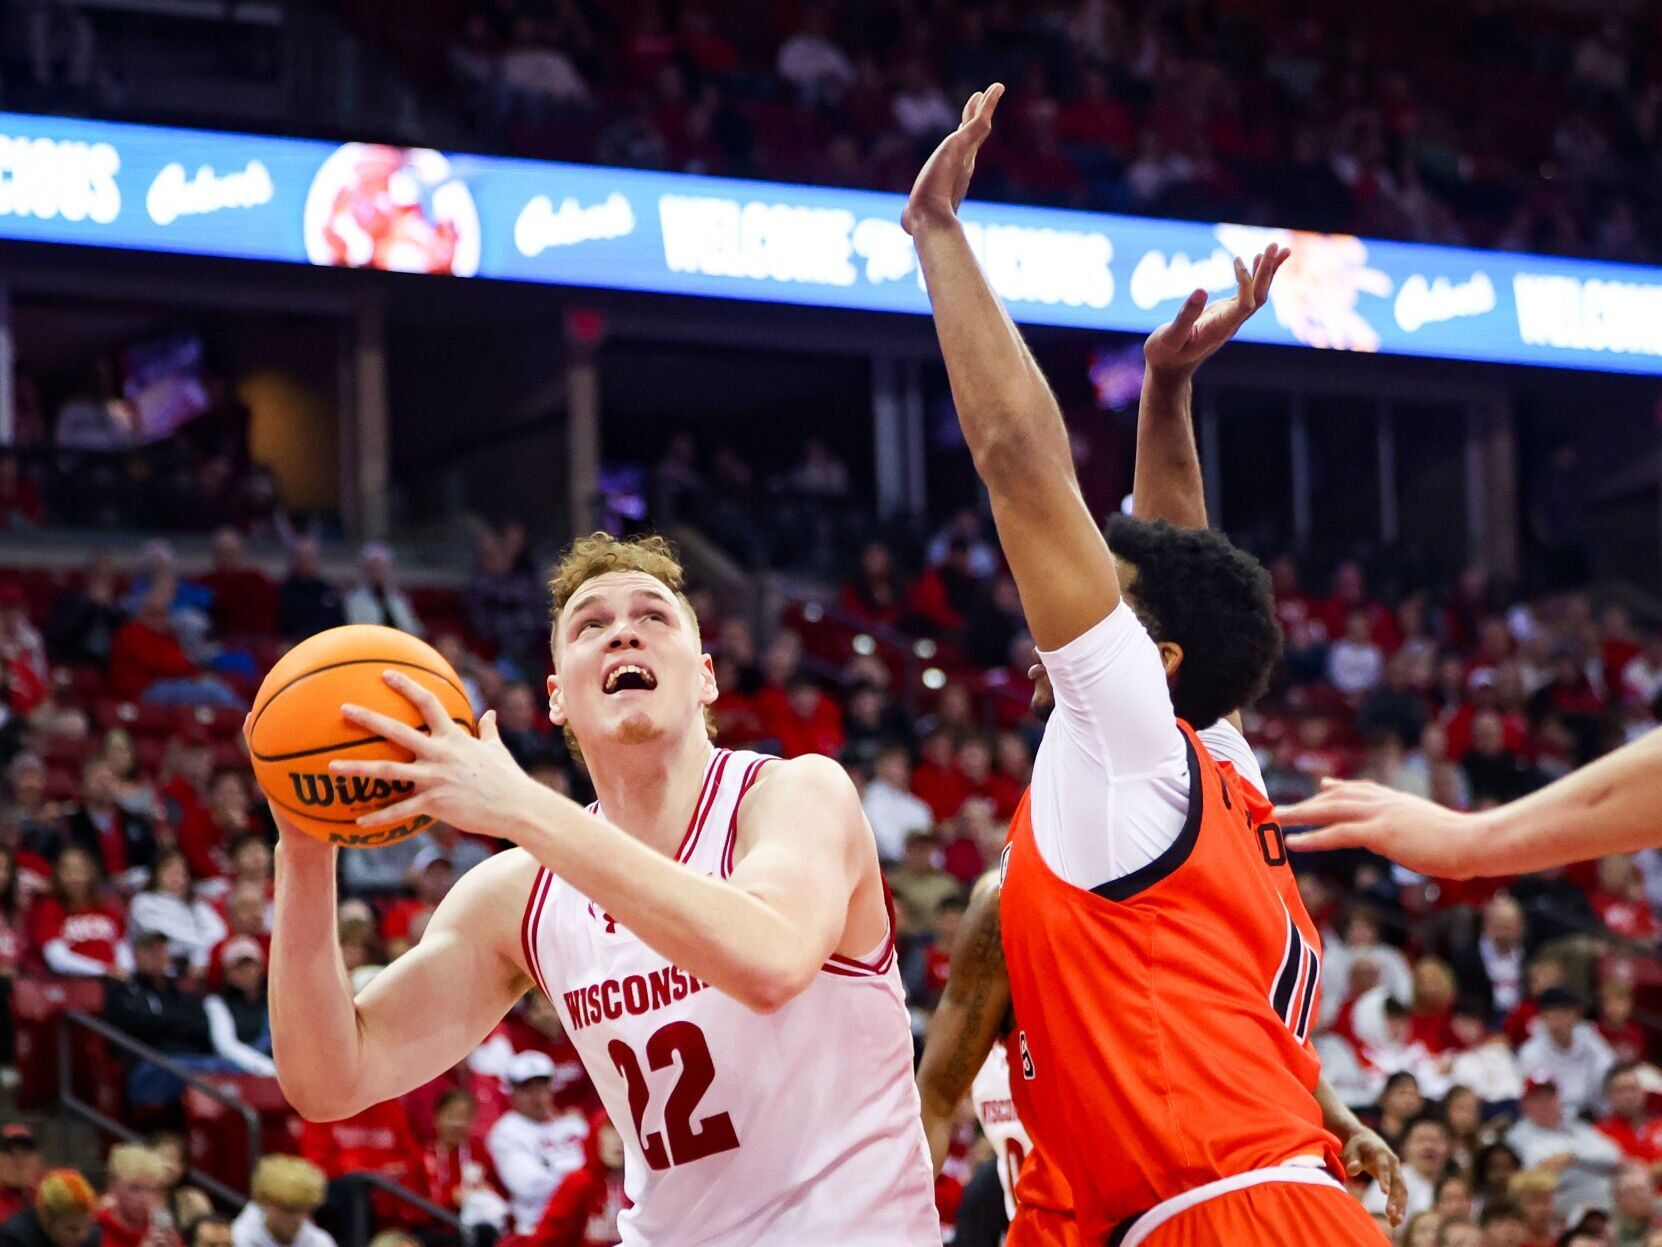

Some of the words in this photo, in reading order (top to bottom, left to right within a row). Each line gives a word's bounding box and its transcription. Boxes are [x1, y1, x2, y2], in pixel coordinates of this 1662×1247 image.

[660, 195, 855, 286] WELCOME
[289, 772, 415, 807] Wilso
[607, 1020, 741, 1171] 22
